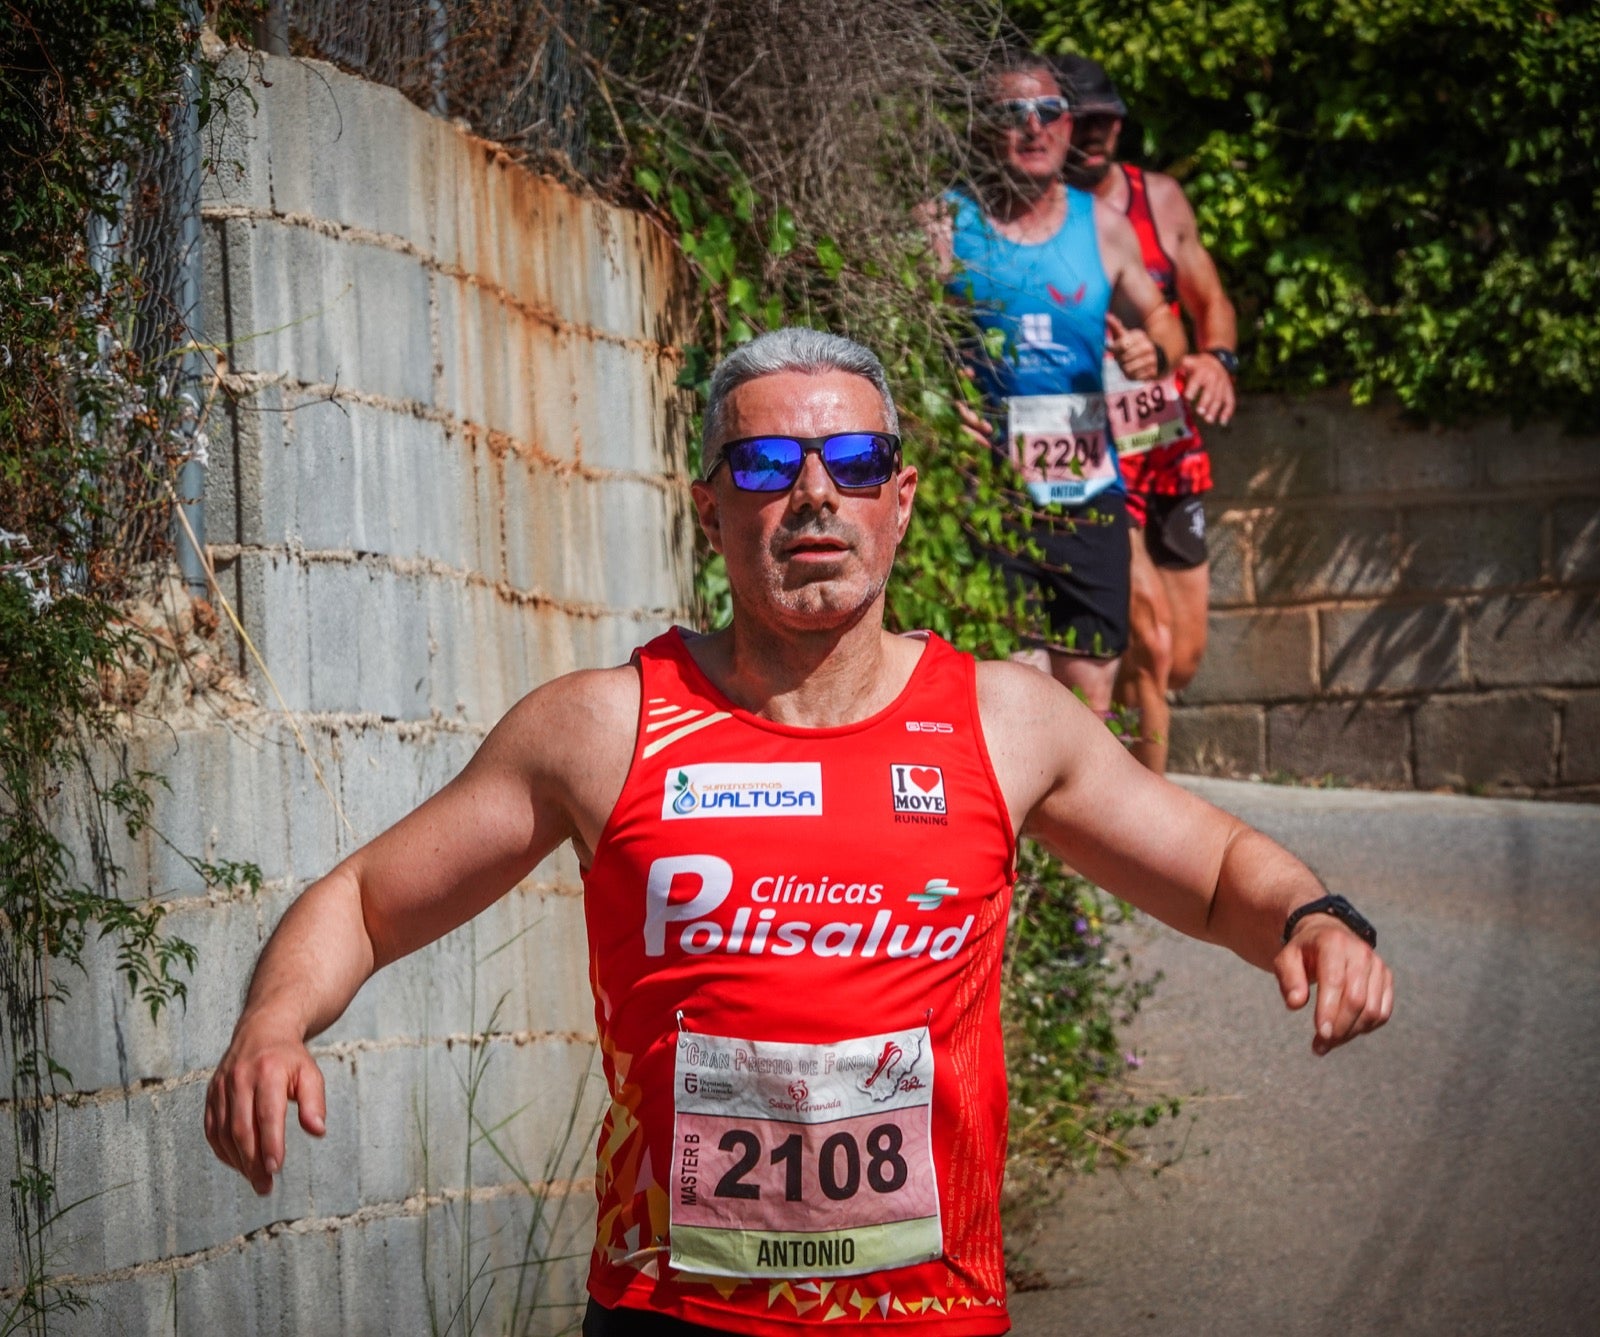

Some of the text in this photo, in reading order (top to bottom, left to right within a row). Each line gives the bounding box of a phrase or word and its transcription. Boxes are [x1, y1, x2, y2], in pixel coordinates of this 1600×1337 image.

[896, 767, 908, 793] I
[895, 794, 945, 811] MOVE
[894, 814, 948, 826] RUNNING
[750, 876, 884, 904] Clínicas
[643, 854, 976, 961] Polisalud
[686, 1042, 730, 1069] GRAN
[800, 1098, 841, 1113] Granada
[681, 1133, 700, 1206] MASTER B
[713, 1123, 908, 1202] 2108
[756, 1238, 855, 1267] ANTONIO
